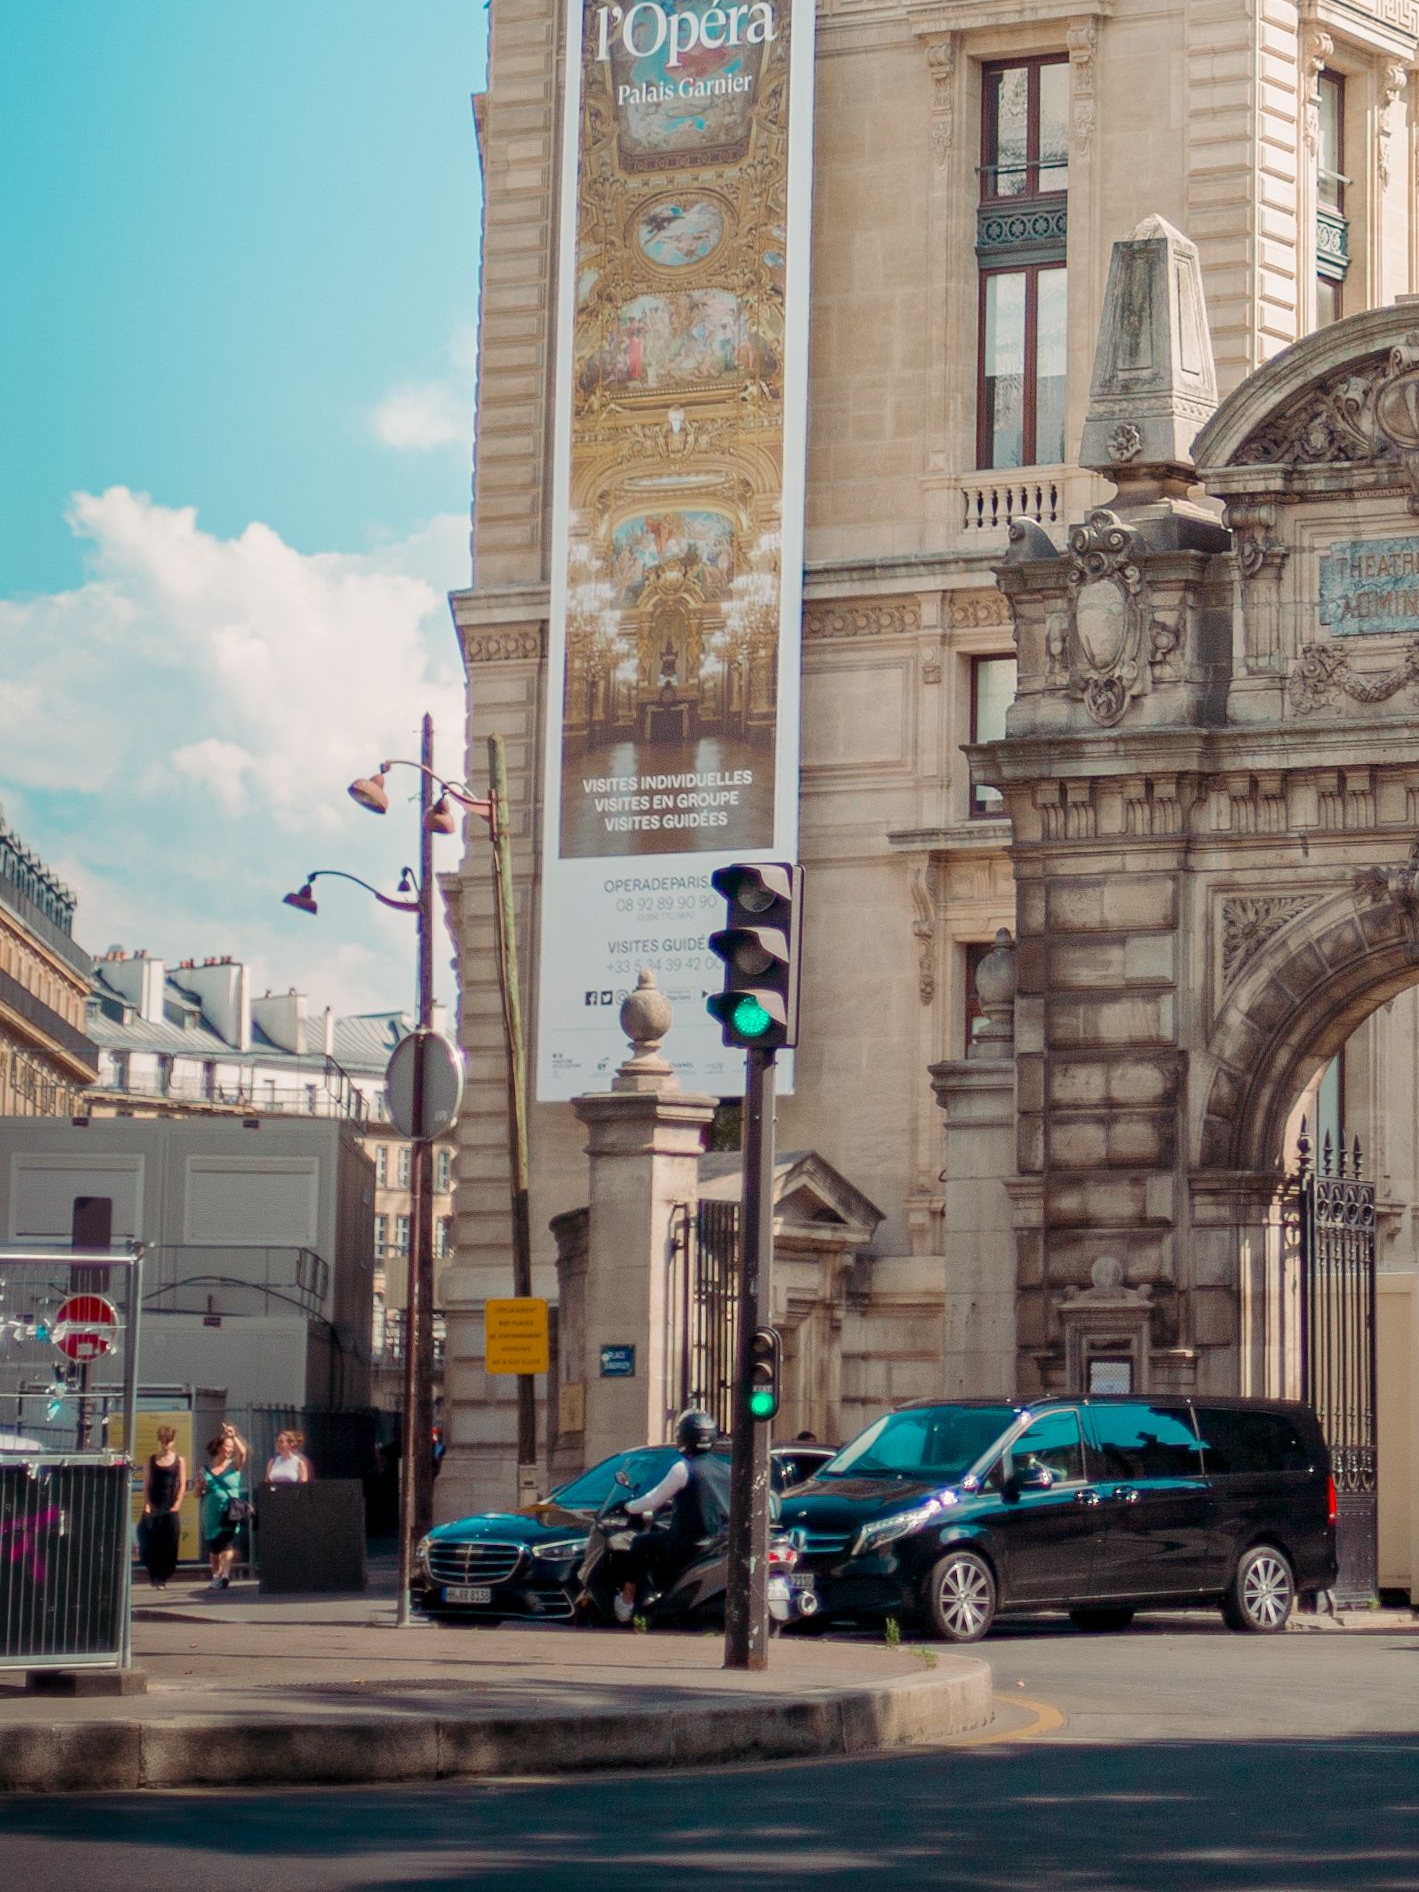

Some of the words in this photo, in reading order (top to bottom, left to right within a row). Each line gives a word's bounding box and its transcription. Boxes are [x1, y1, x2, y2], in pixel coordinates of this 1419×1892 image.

[618, 82, 674, 106] Palais
[678, 73, 752, 99] Garnier
[583, 776, 638, 793] VISITES
[640, 770, 752, 790] INDIVIDUELLES
[594, 795, 650, 812] VISITES
[652, 794, 674, 809] EN
[677, 791, 740, 808] GROUPE
[605, 815, 660, 832] VISITES
[662, 809, 728, 830] GUIDÉES
[616, 898, 634, 912] 08
[637, 898, 654, 911] 92
[657, 896, 674, 910] 89
[678, 896, 696, 909] 90
[700, 894, 718, 908] 90
[608, 939, 658, 954] VISITES
[662, 936, 706, 952] GUIDÉ
[606, 960, 630, 974] +33
[665, 958, 682, 972] 39
[685, 957, 701, 970] 42
